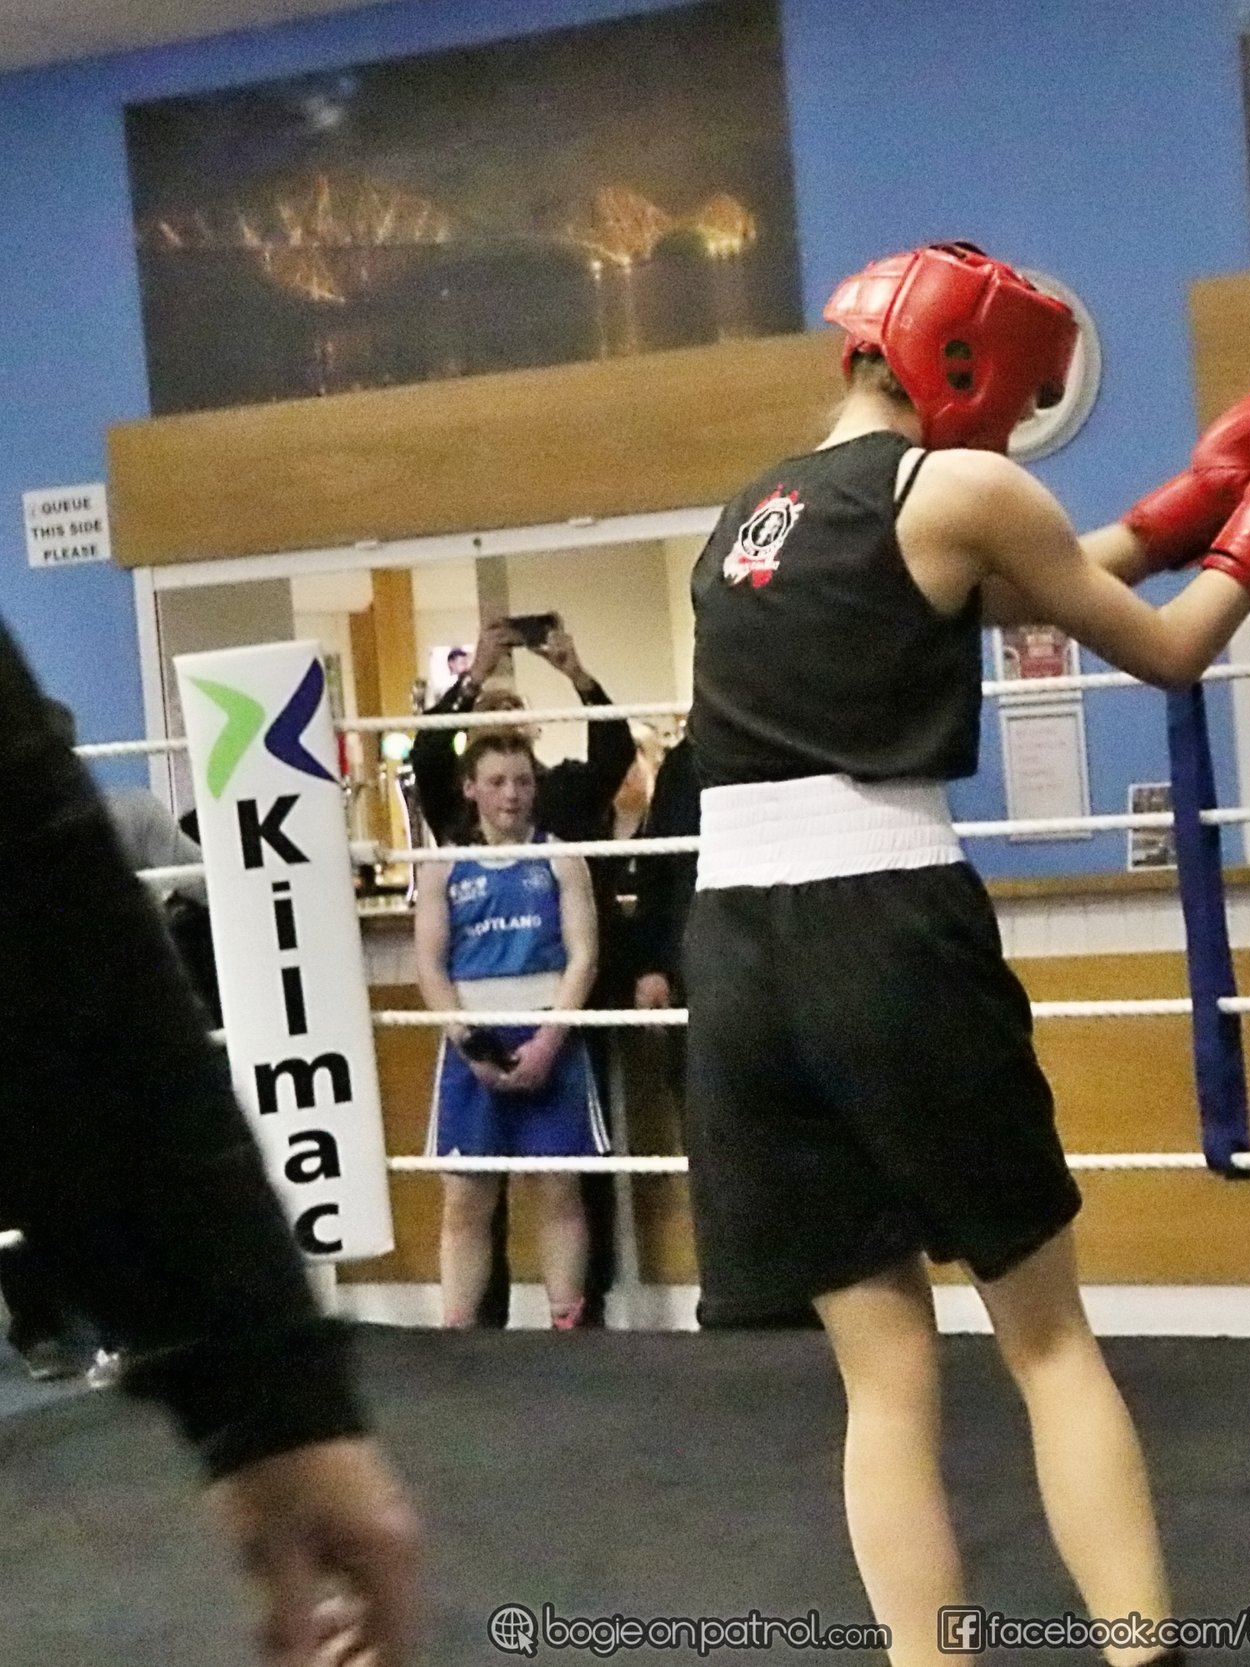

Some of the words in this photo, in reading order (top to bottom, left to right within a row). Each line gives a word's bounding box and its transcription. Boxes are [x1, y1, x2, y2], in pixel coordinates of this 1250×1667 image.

[42, 498, 90, 515] QUEUE
[32, 525, 65, 539] THIS
[70, 520, 102, 535] SIDE
[236, 795, 353, 1255] Kilmac
